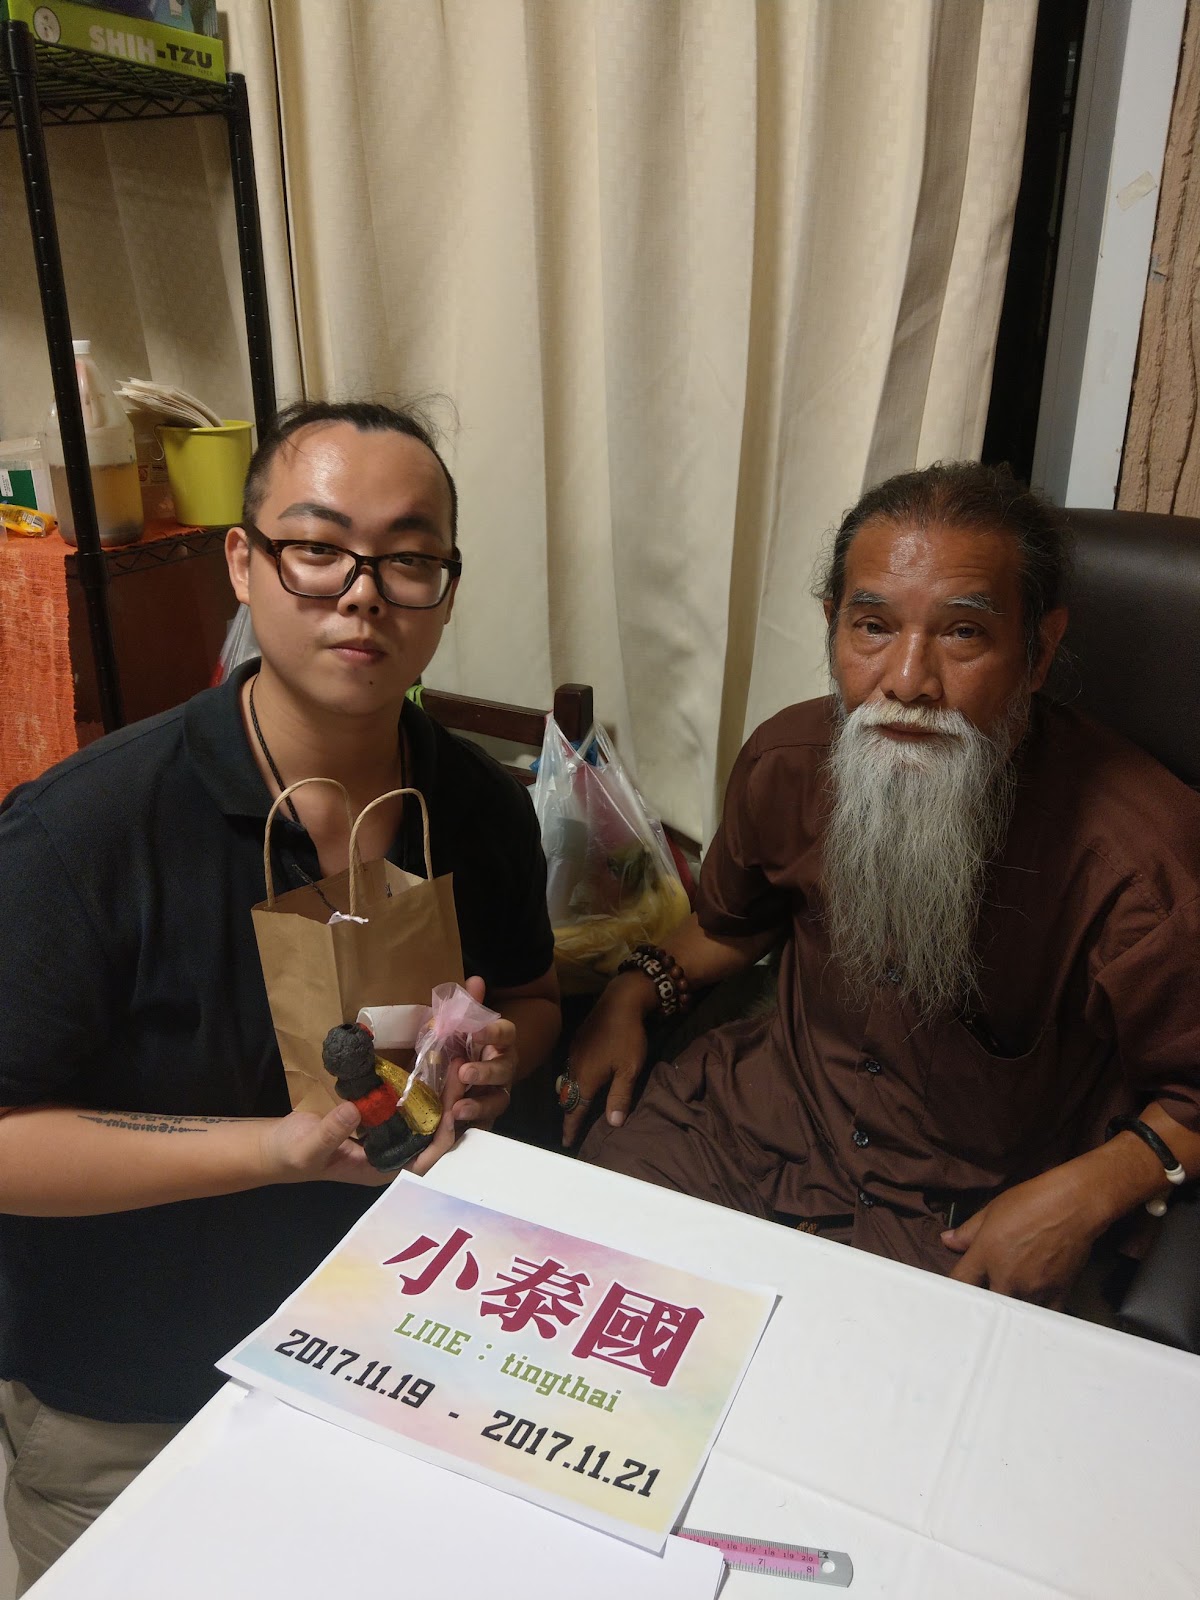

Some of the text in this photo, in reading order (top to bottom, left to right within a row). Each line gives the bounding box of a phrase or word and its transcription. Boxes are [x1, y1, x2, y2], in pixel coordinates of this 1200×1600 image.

[89, 25, 212, 69] SHIH-TZU
[382, 1228, 705, 1387] 小泰國
[394, 1312, 472, 1356] LINE
[500, 1353, 623, 1413] tinythai
[274, 1328, 436, 1409] 2017.11.19
[480, 1409, 662, 1498] 2017.11.21
